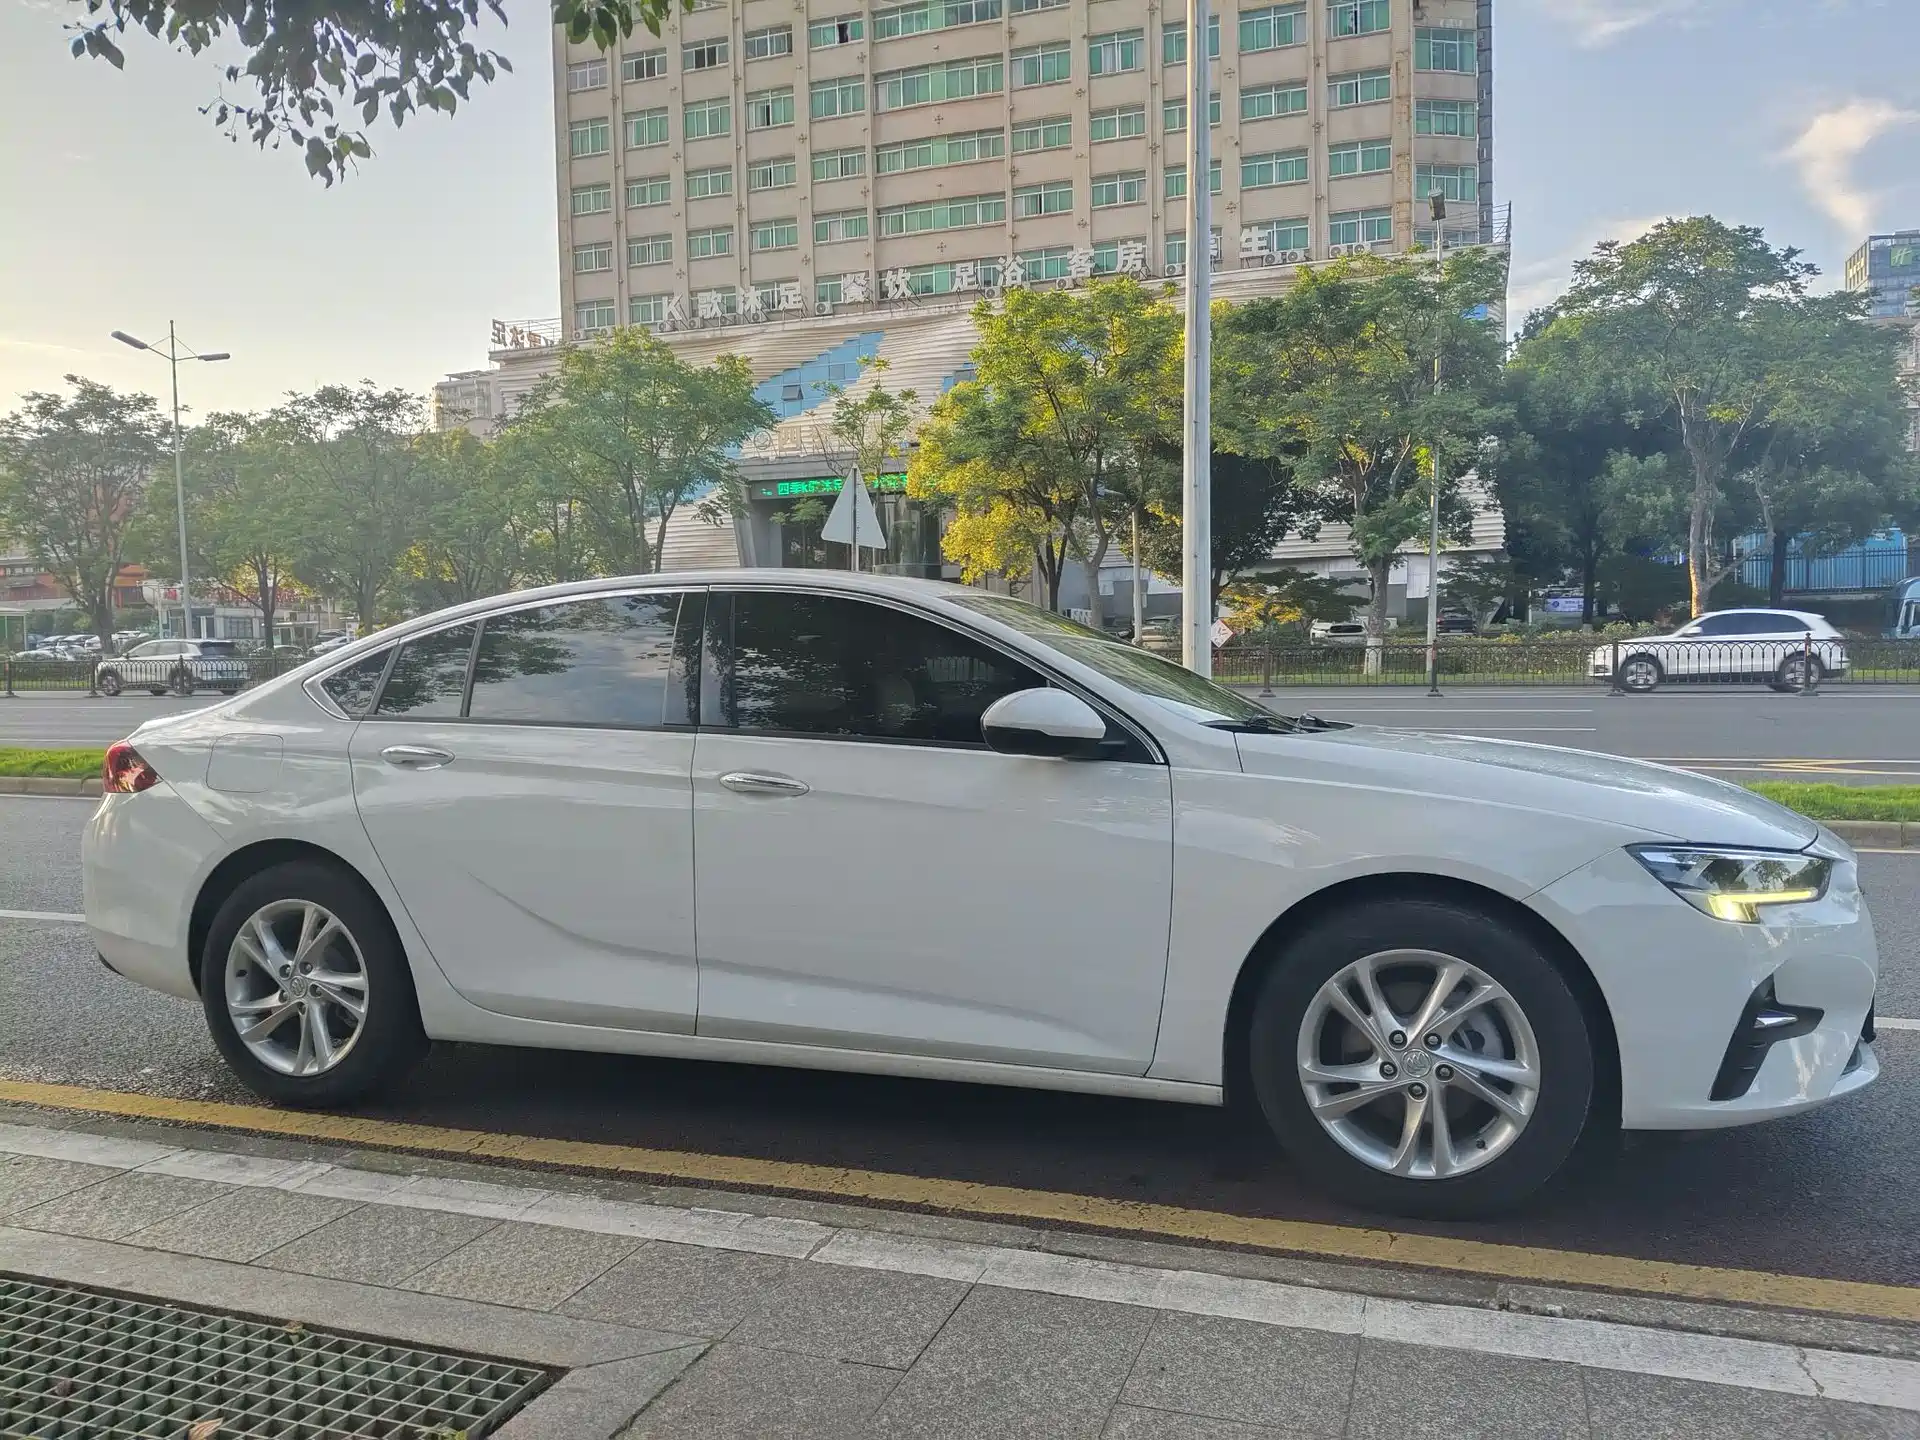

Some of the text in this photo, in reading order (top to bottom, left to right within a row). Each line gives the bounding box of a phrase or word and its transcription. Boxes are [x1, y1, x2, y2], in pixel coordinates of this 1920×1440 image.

[662, 282, 803, 321] K歌沐足
[951, 254, 1027, 293] 足浴
[1066, 241, 1147, 278] 客房
